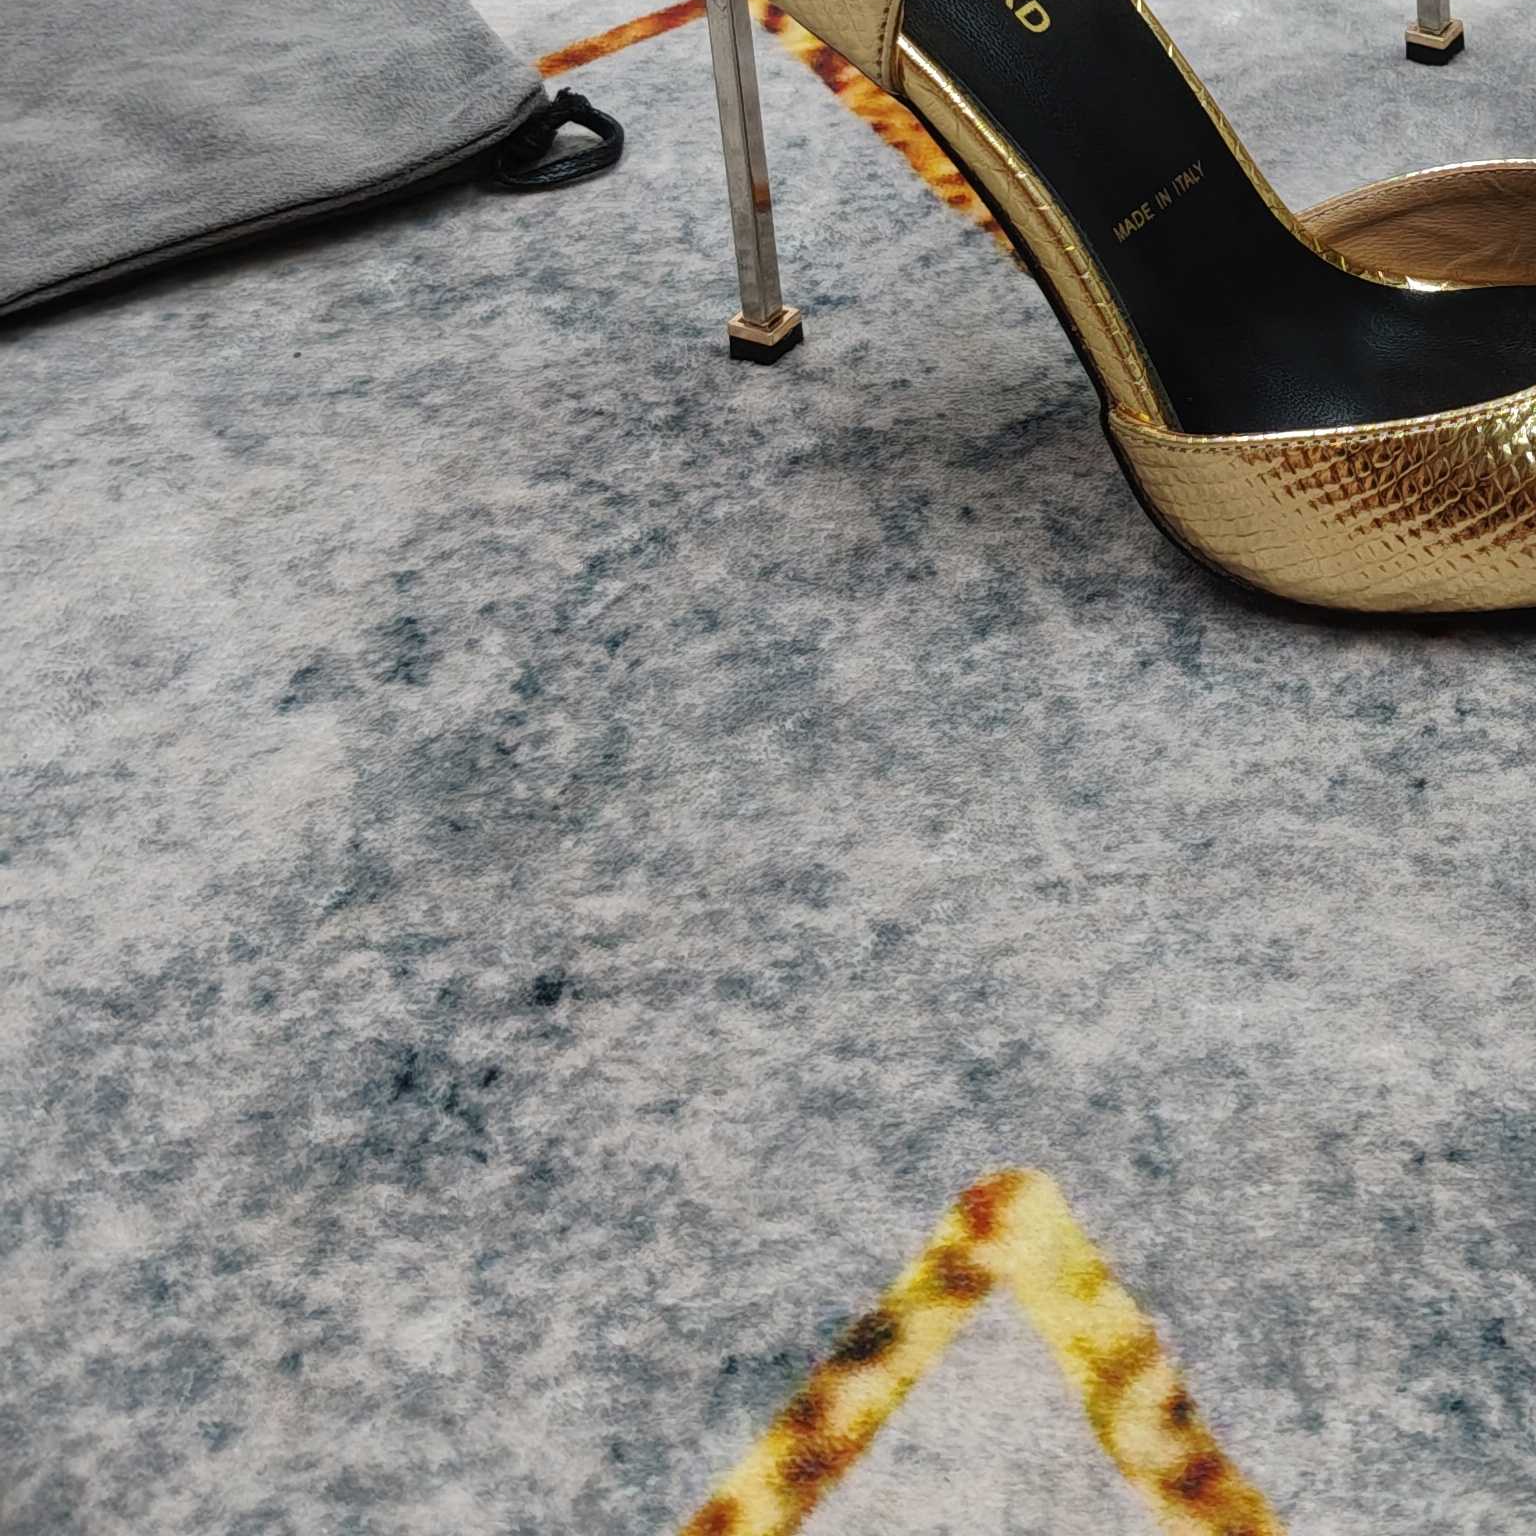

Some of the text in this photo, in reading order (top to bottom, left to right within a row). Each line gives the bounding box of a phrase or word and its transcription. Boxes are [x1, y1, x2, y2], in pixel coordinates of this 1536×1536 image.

[1112, 160, 1204, 243] MADE IN ITALY
